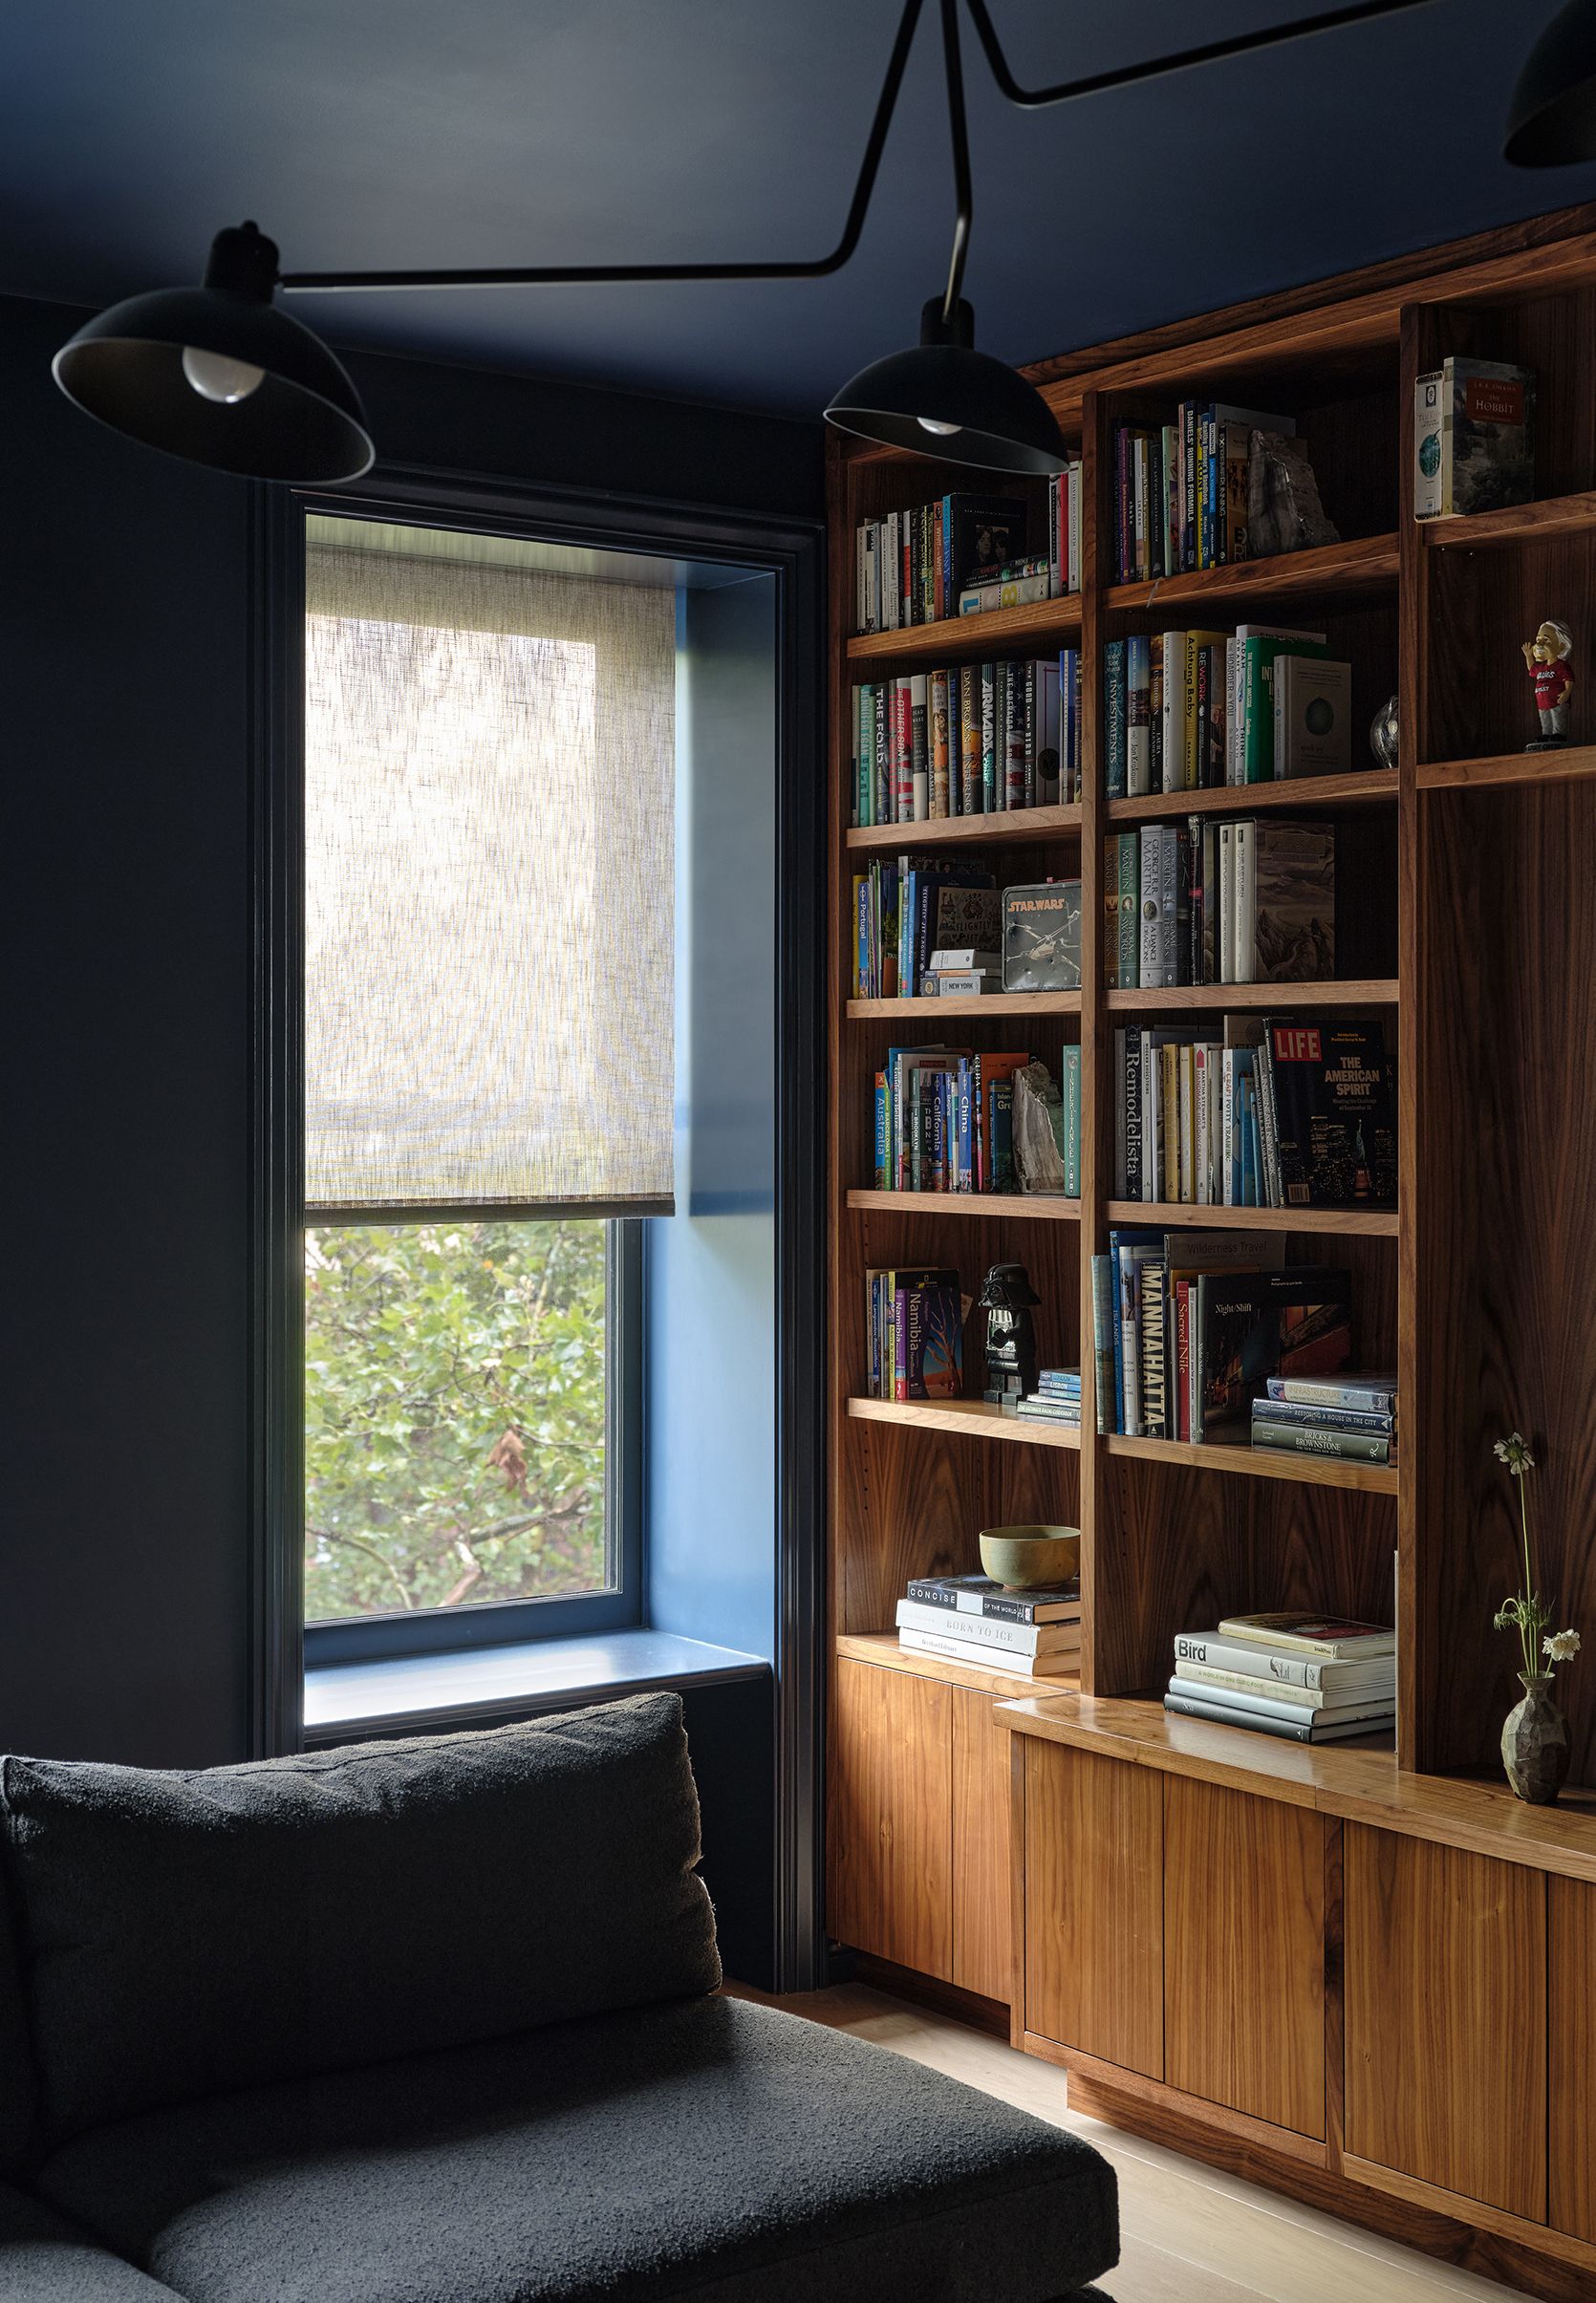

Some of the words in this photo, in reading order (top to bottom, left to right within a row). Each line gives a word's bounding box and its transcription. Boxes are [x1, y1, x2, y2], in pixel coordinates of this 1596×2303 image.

[1476, 399, 1515, 414] HOBBIT
[1186, 636, 1196, 685] Achtung
[1227, 654, 1236, 692] HOARDER
[1198, 652, 1207, 702] REWORK
[860, 688, 870, 731] JENNIFER
[875, 688, 884, 721] THE
[1132, 693, 1137, 701] OF
[1186, 688, 1196, 719] Baby
[1227, 699, 1236, 717] YOU
[981, 678, 994, 757] ARMADA
[860, 732, 870, 756] EGAN
[875, 722, 884, 764] FOLD
[963, 756, 972, 814] INFERNO
[1143, 839, 1152, 896] MARTIN
[1008, 901, 1037, 913] STAR
[1037, 898, 1065, 910] WARS
[956, 920, 991, 932] SLIGHTLY
[1276, 1032, 1321, 1059] LIFE
[1225, 1061, 1232, 1072] OH
[1325, 1069, 1381, 1082] AMERICAN
[1340, 1056, 1361, 1068] THE
[894, 1094, 899, 1103] to
[1336, 1083, 1371, 1096] SPIRIT
[933, 1096, 941, 1152] California
[960, 1095, 969, 1134] China
[1126, 1051, 1141, 1176] Remodelista
[1261, 1074, 1272, 1129] UNDERNEATH
[1267, 1149, 1276, 1175] YORK
[1187, 1241, 1238, 1255] Wilderness
[1240, 1240, 1267, 1252] Travel
[910, 1292, 922, 1352] Namibia
[1178, 1302, 1189, 1344] Sacred
[1141, 1270, 1165, 1426] MANNAHATTA
[1178, 1346, 1189, 1375] Nile
[1294, 1410, 1322, 1420] RESTORING
[1327, 1414, 1347, 1423] HOUSE
[1351, 1416, 1364, 1425] THE
[1364, 1418, 1377, 1427] CITY
[1295, 1436, 1342, 1452] BROWNSTONE
[1304, 1430, 1326, 1440] BRICKS
[910, 1587, 957, 1604] CONCISE
[1001, 1605, 1018, 1615] WORLD
[946, 1620, 974, 1634] BORN
[977, 1625, 993, 1637] TO
[996, 1629, 1014, 1643] ICE
[1177, 1639, 1207, 1663] Bird
